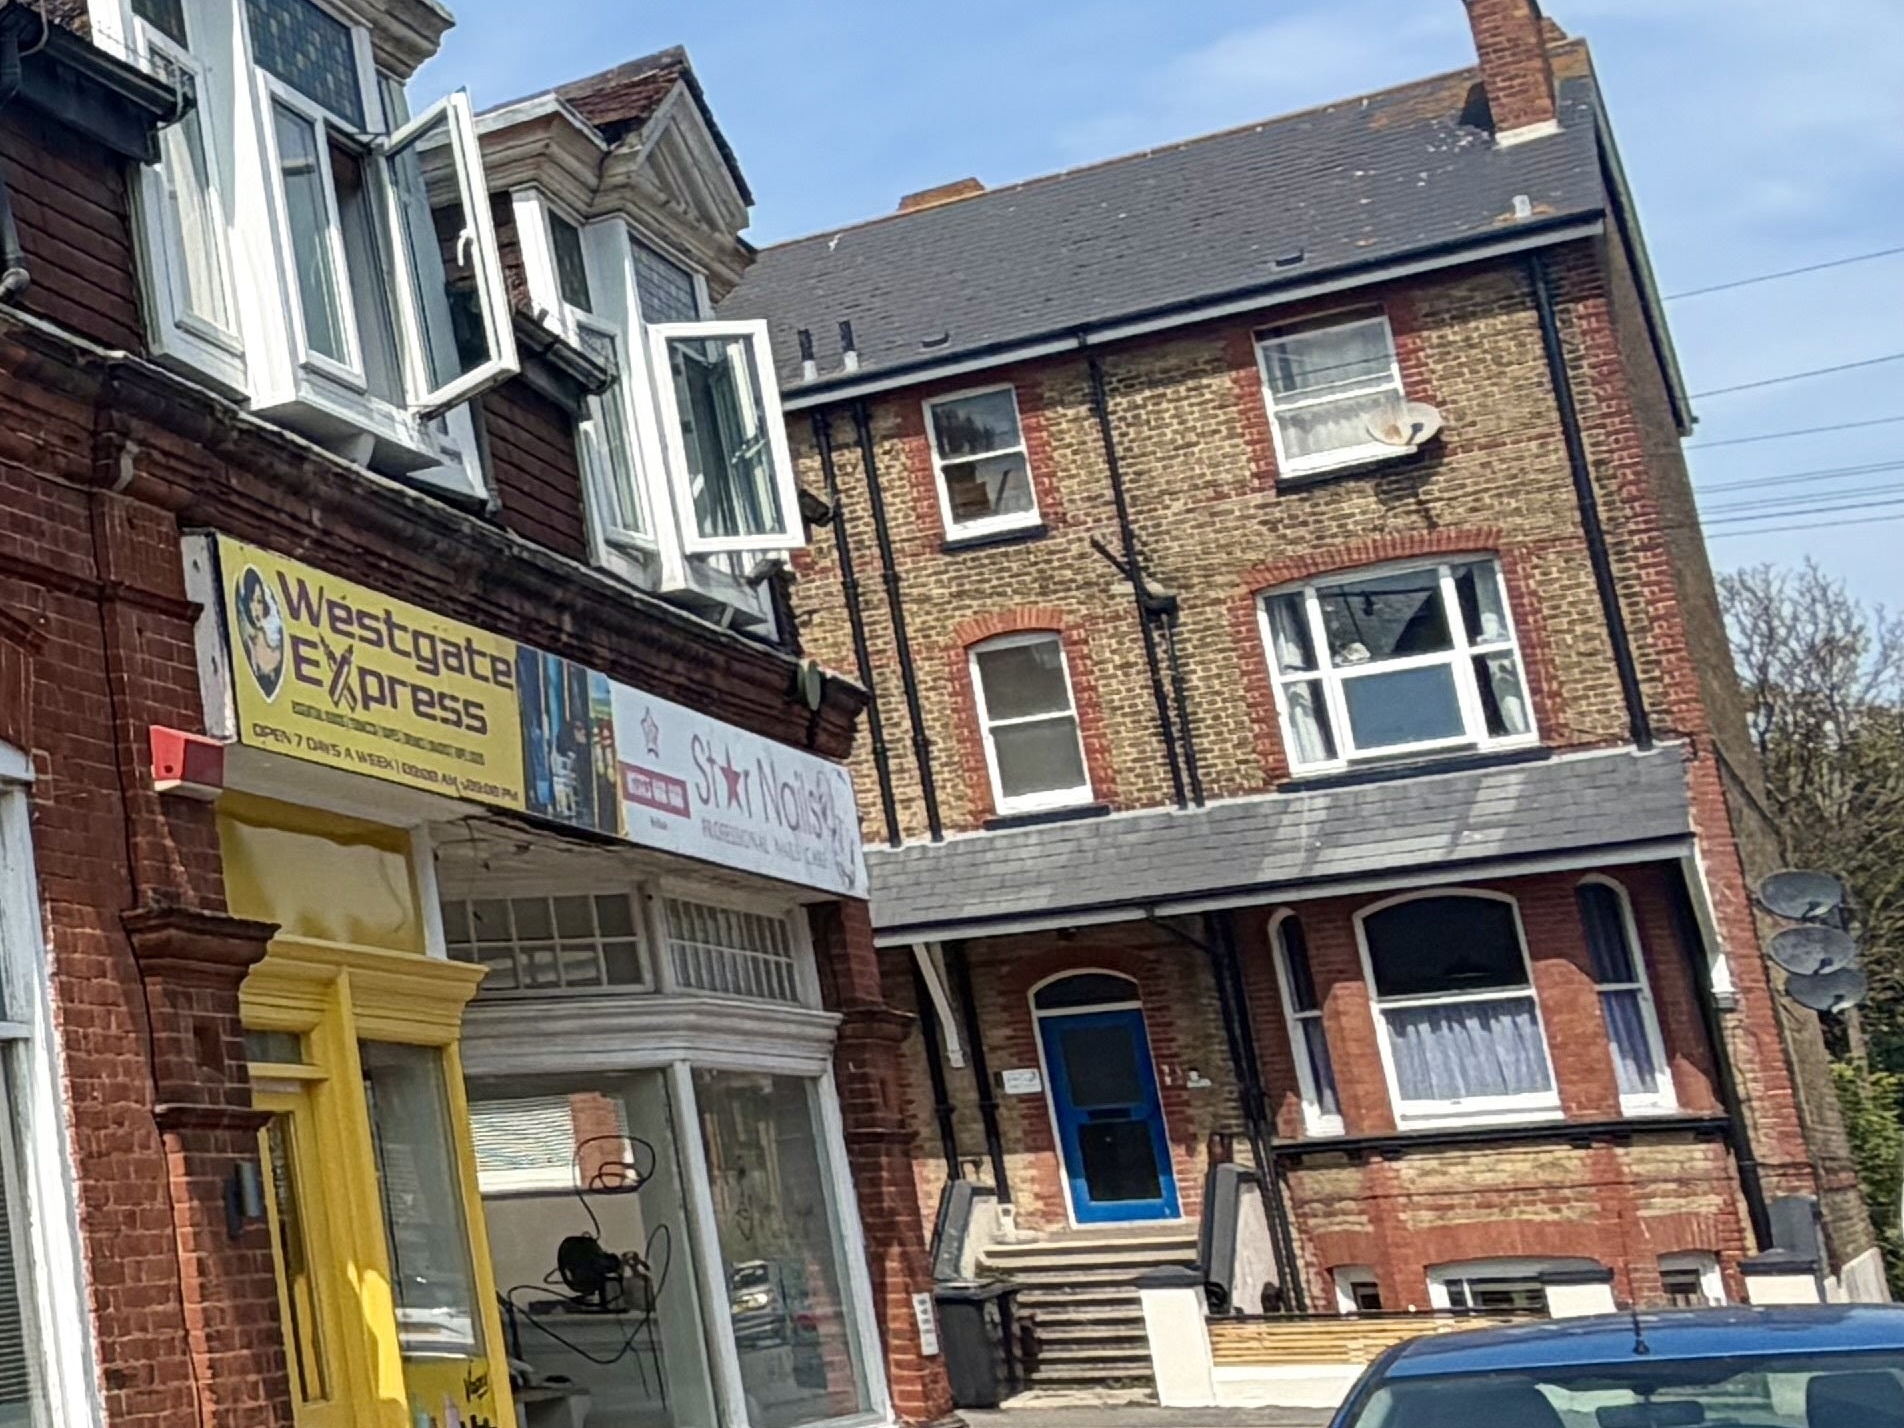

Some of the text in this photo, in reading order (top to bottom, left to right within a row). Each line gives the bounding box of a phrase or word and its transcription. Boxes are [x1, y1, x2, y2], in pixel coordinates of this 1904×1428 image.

[276, 569, 515, 692] Westgate
[252, 722, 292, 745] OPEN
[293, 732, 304, 748] 7
[306, 736, 342, 759] DAYS
[344, 746, 356, 762] A
[355, 749, 394, 771] WEEK
[756, 756, 823, 840] Nails
